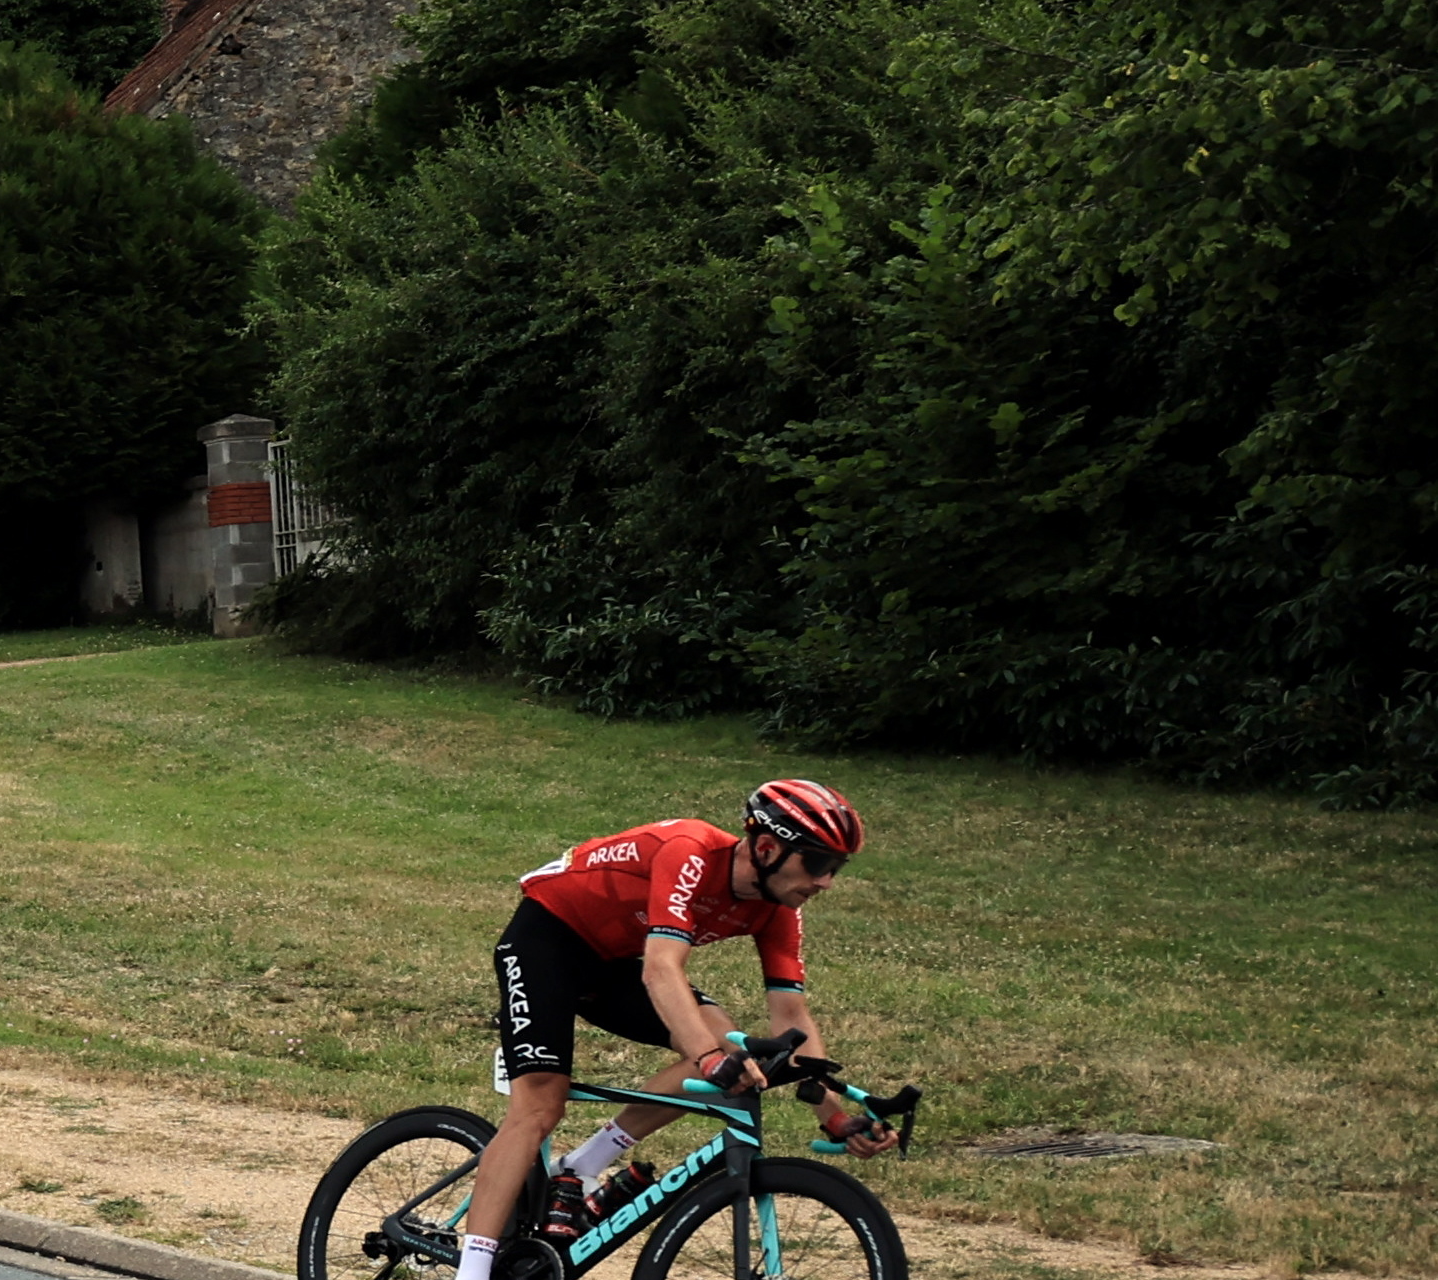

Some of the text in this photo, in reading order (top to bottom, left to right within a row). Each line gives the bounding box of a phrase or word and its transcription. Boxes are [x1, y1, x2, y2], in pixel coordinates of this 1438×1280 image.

[586, 842, 640, 868] ARKEA
[667, 854, 707, 922] ARKEA
[503, 955, 531, 1035] ARKEA
[569, 1133, 725, 1266] Bianchi
